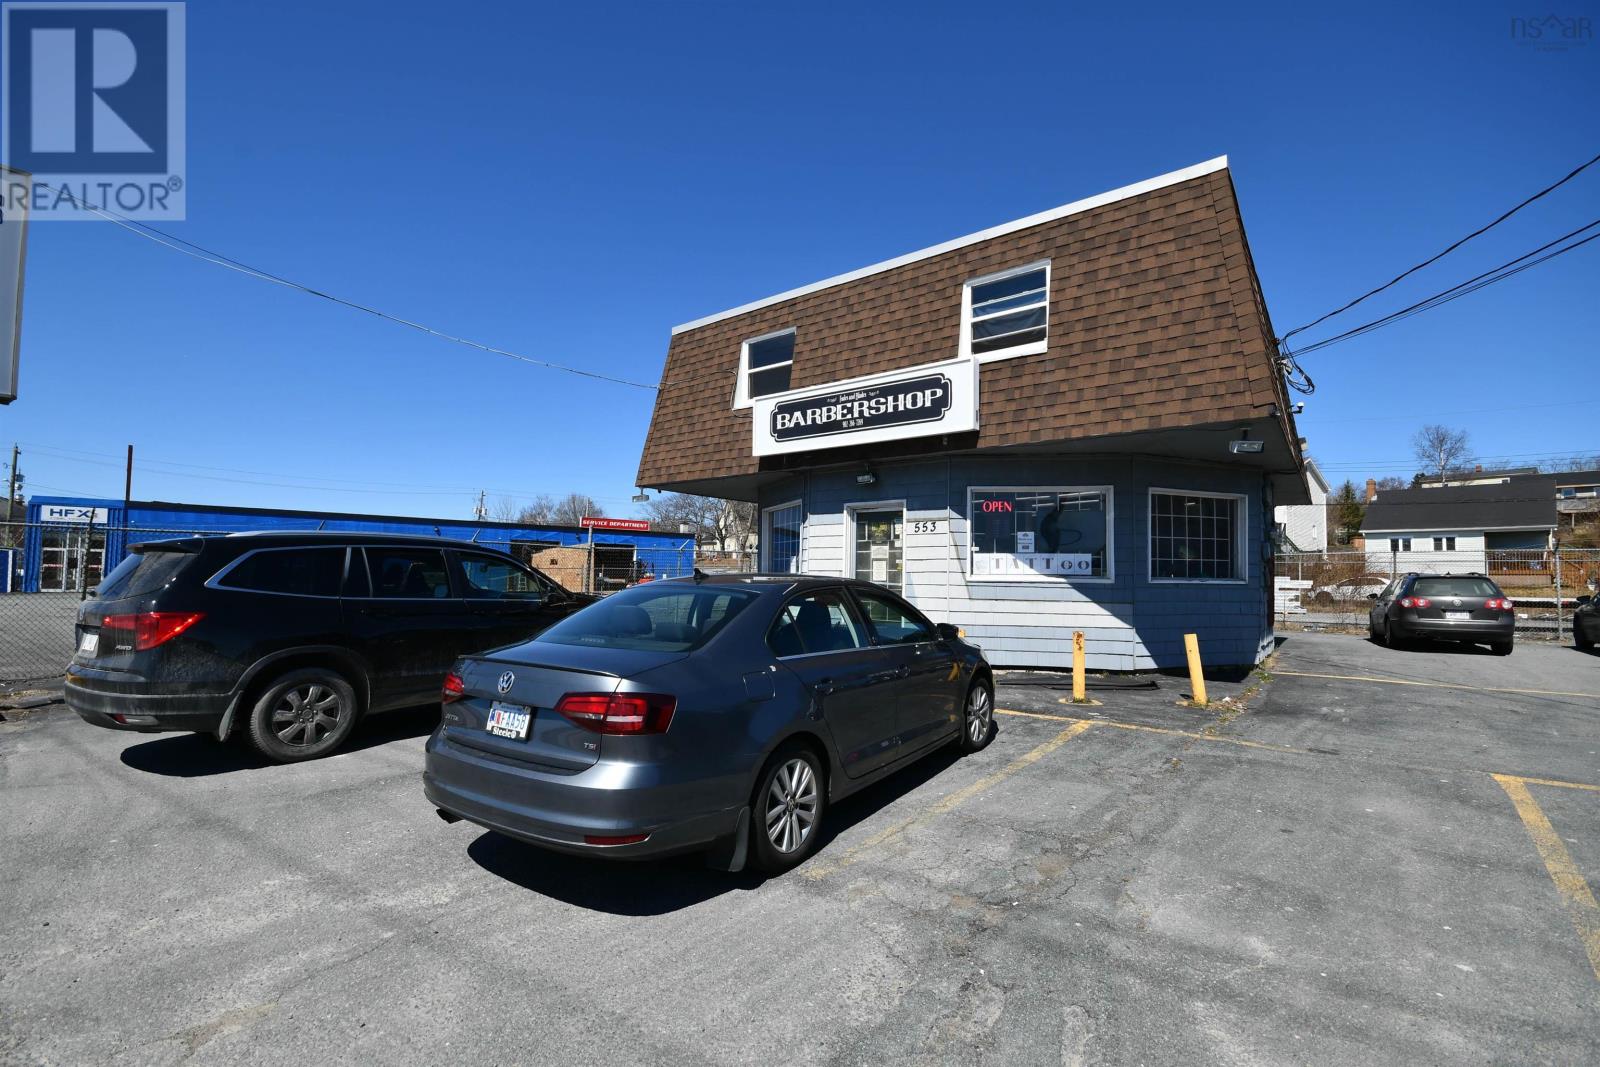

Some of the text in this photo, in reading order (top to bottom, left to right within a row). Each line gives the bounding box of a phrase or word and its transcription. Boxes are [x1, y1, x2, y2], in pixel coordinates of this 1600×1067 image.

[776, 388, 943, 430] BARBERSHOP
[982, 500, 1013, 513] OPEN
[49, 508, 91, 518] HFX
[914, 521, 938, 533] 553
